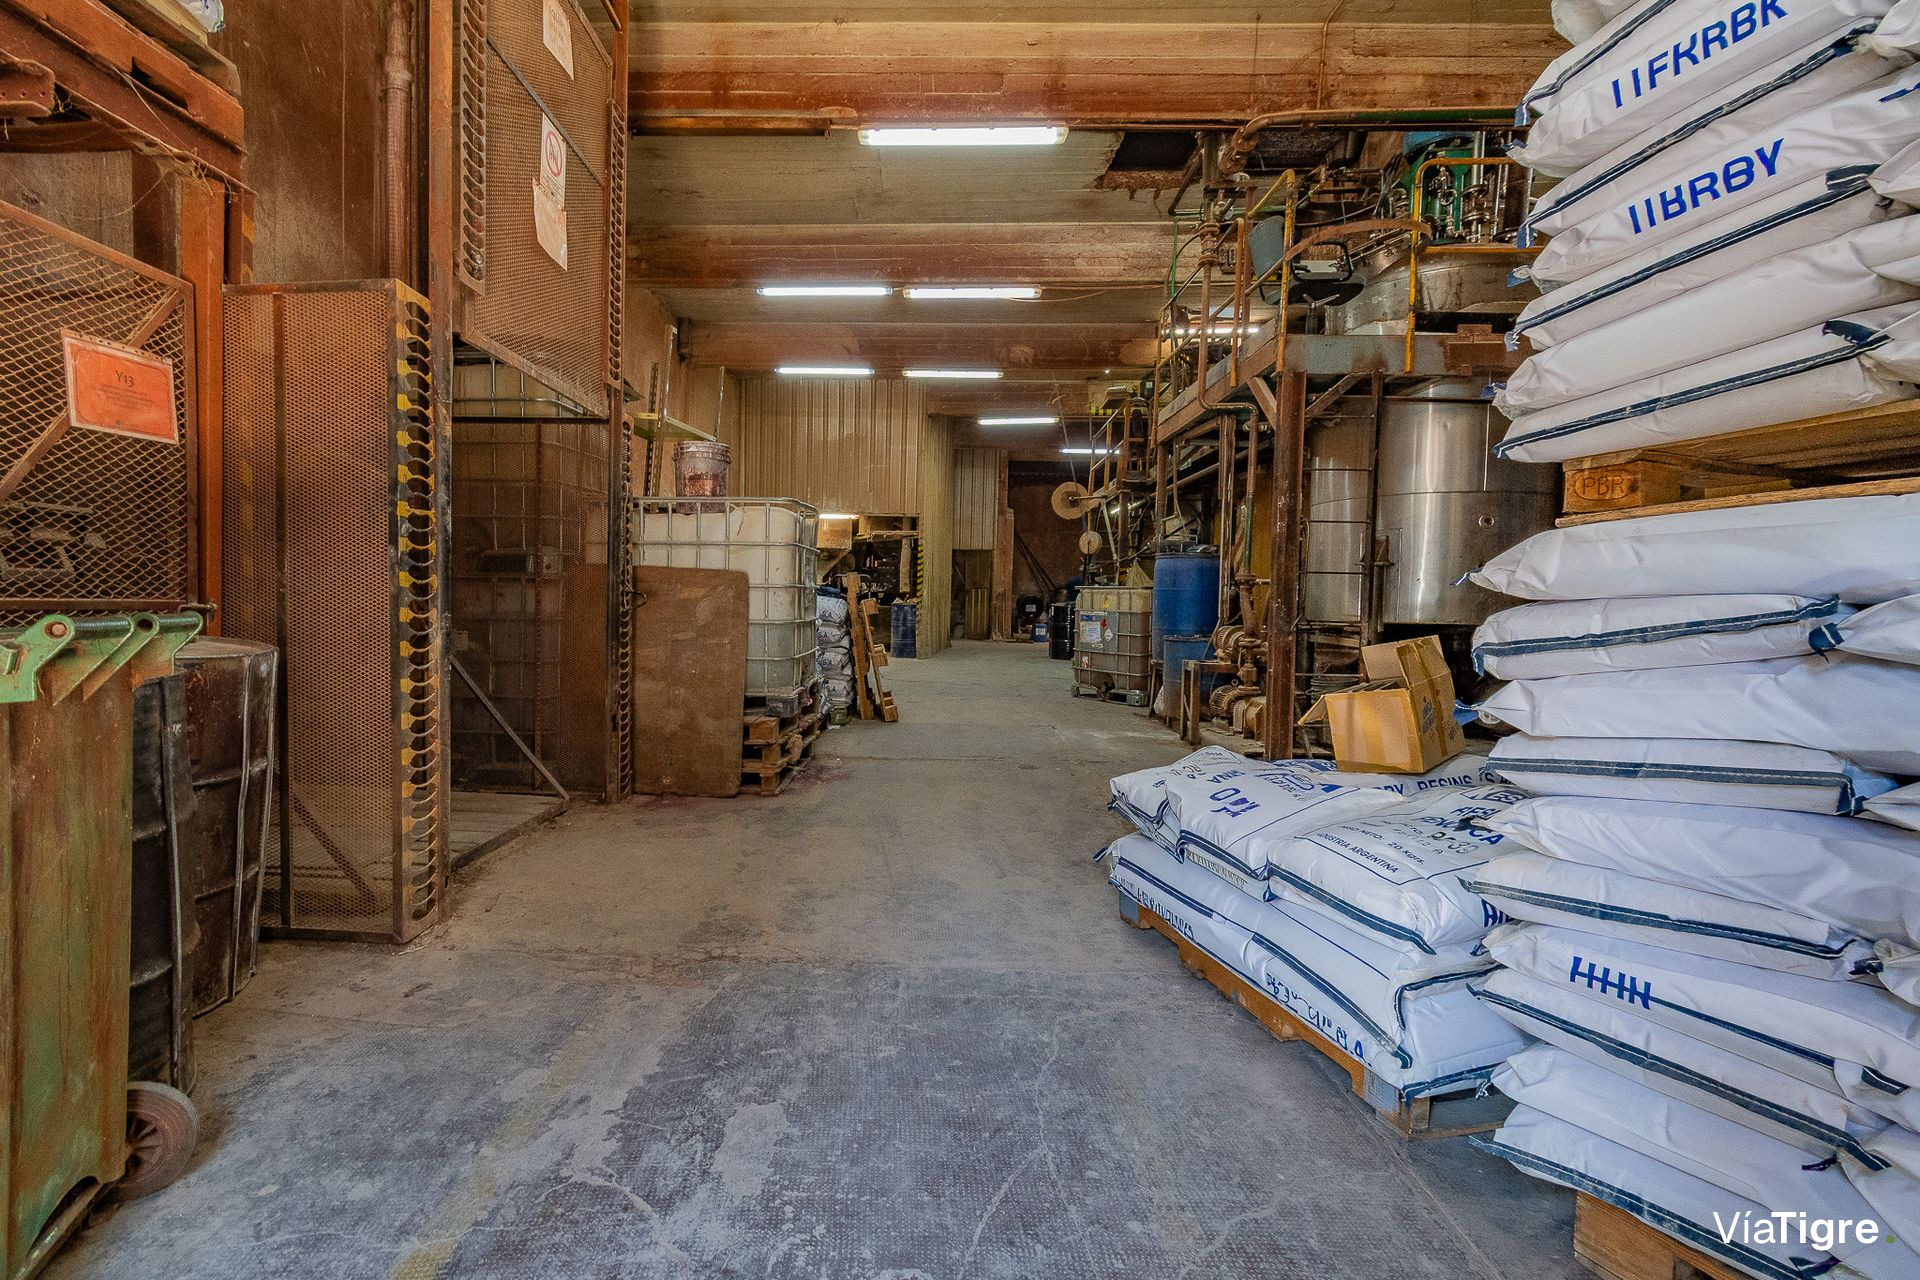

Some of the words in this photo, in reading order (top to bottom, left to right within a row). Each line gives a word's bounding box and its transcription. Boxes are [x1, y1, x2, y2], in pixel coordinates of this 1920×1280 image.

[115, 370, 135, 388] Y13
[1582, 474, 1625, 496] PBR
[1349, 846, 1399, 874] ARGENTINA
